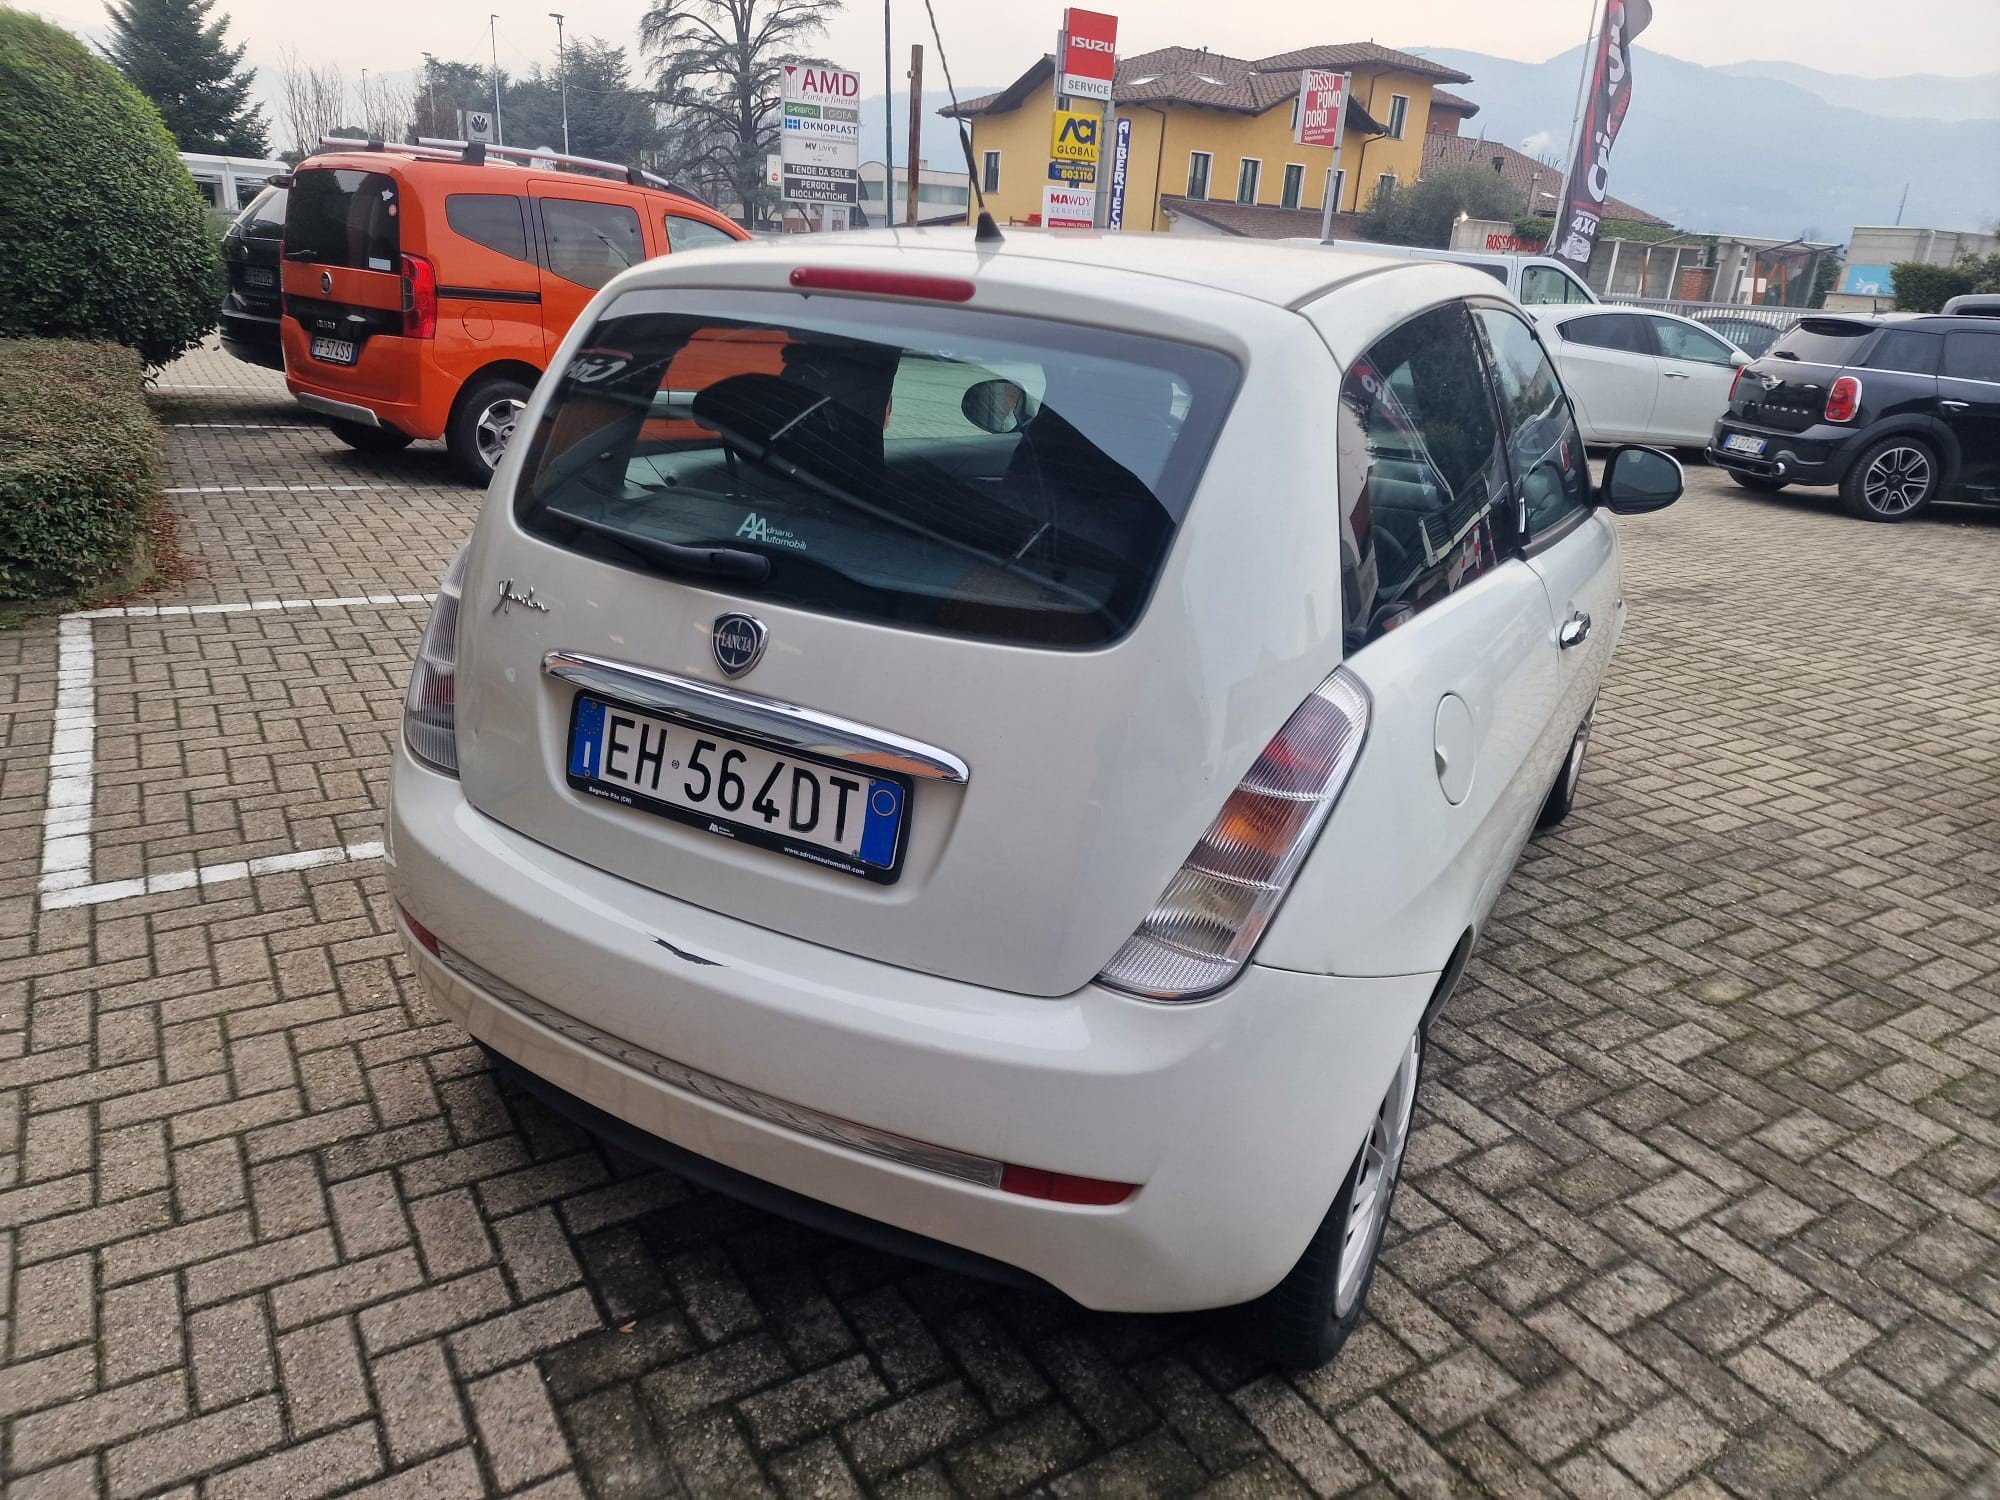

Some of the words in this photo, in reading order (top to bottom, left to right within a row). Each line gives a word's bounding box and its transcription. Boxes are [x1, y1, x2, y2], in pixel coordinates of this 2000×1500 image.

[1071, 35, 1114, 54] ISUZU
[802, 68, 859, 97] AMD
[1068, 79, 1109, 95] SERVICE
[1308, 73, 1335, 92] ROSSO
[802, 92, 823, 102] Porte
[1317, 90, 1341, 109] POMO
[1305, 109, 1327, 128] DORO
[803, 121, 858, 135] OKNOPLAST
[805, 142, 817, 151] MV
[819, 143, 838, 155] Living
[1057, 145, 1095, 158] GLOBAL
[792, 164, 817, 176] TENDE
[818, 167, 829, 176] DA
[830, 168, 850, 178] SOLE
[1109, 121, 1131, 232] ALBERTECH
[801, 180, 836, 191] PERGOLE
[790, 190, 848, 202] BIOCLIMATICHE
[1050, 193, 1092, 206] MAWDY
[1050, 206, 1091, 216] SERVICES
[720, 631, 752, 653] LANCIA
[605, 714, 667, 791] EH
[683, 738, 860, 843] 564DT
